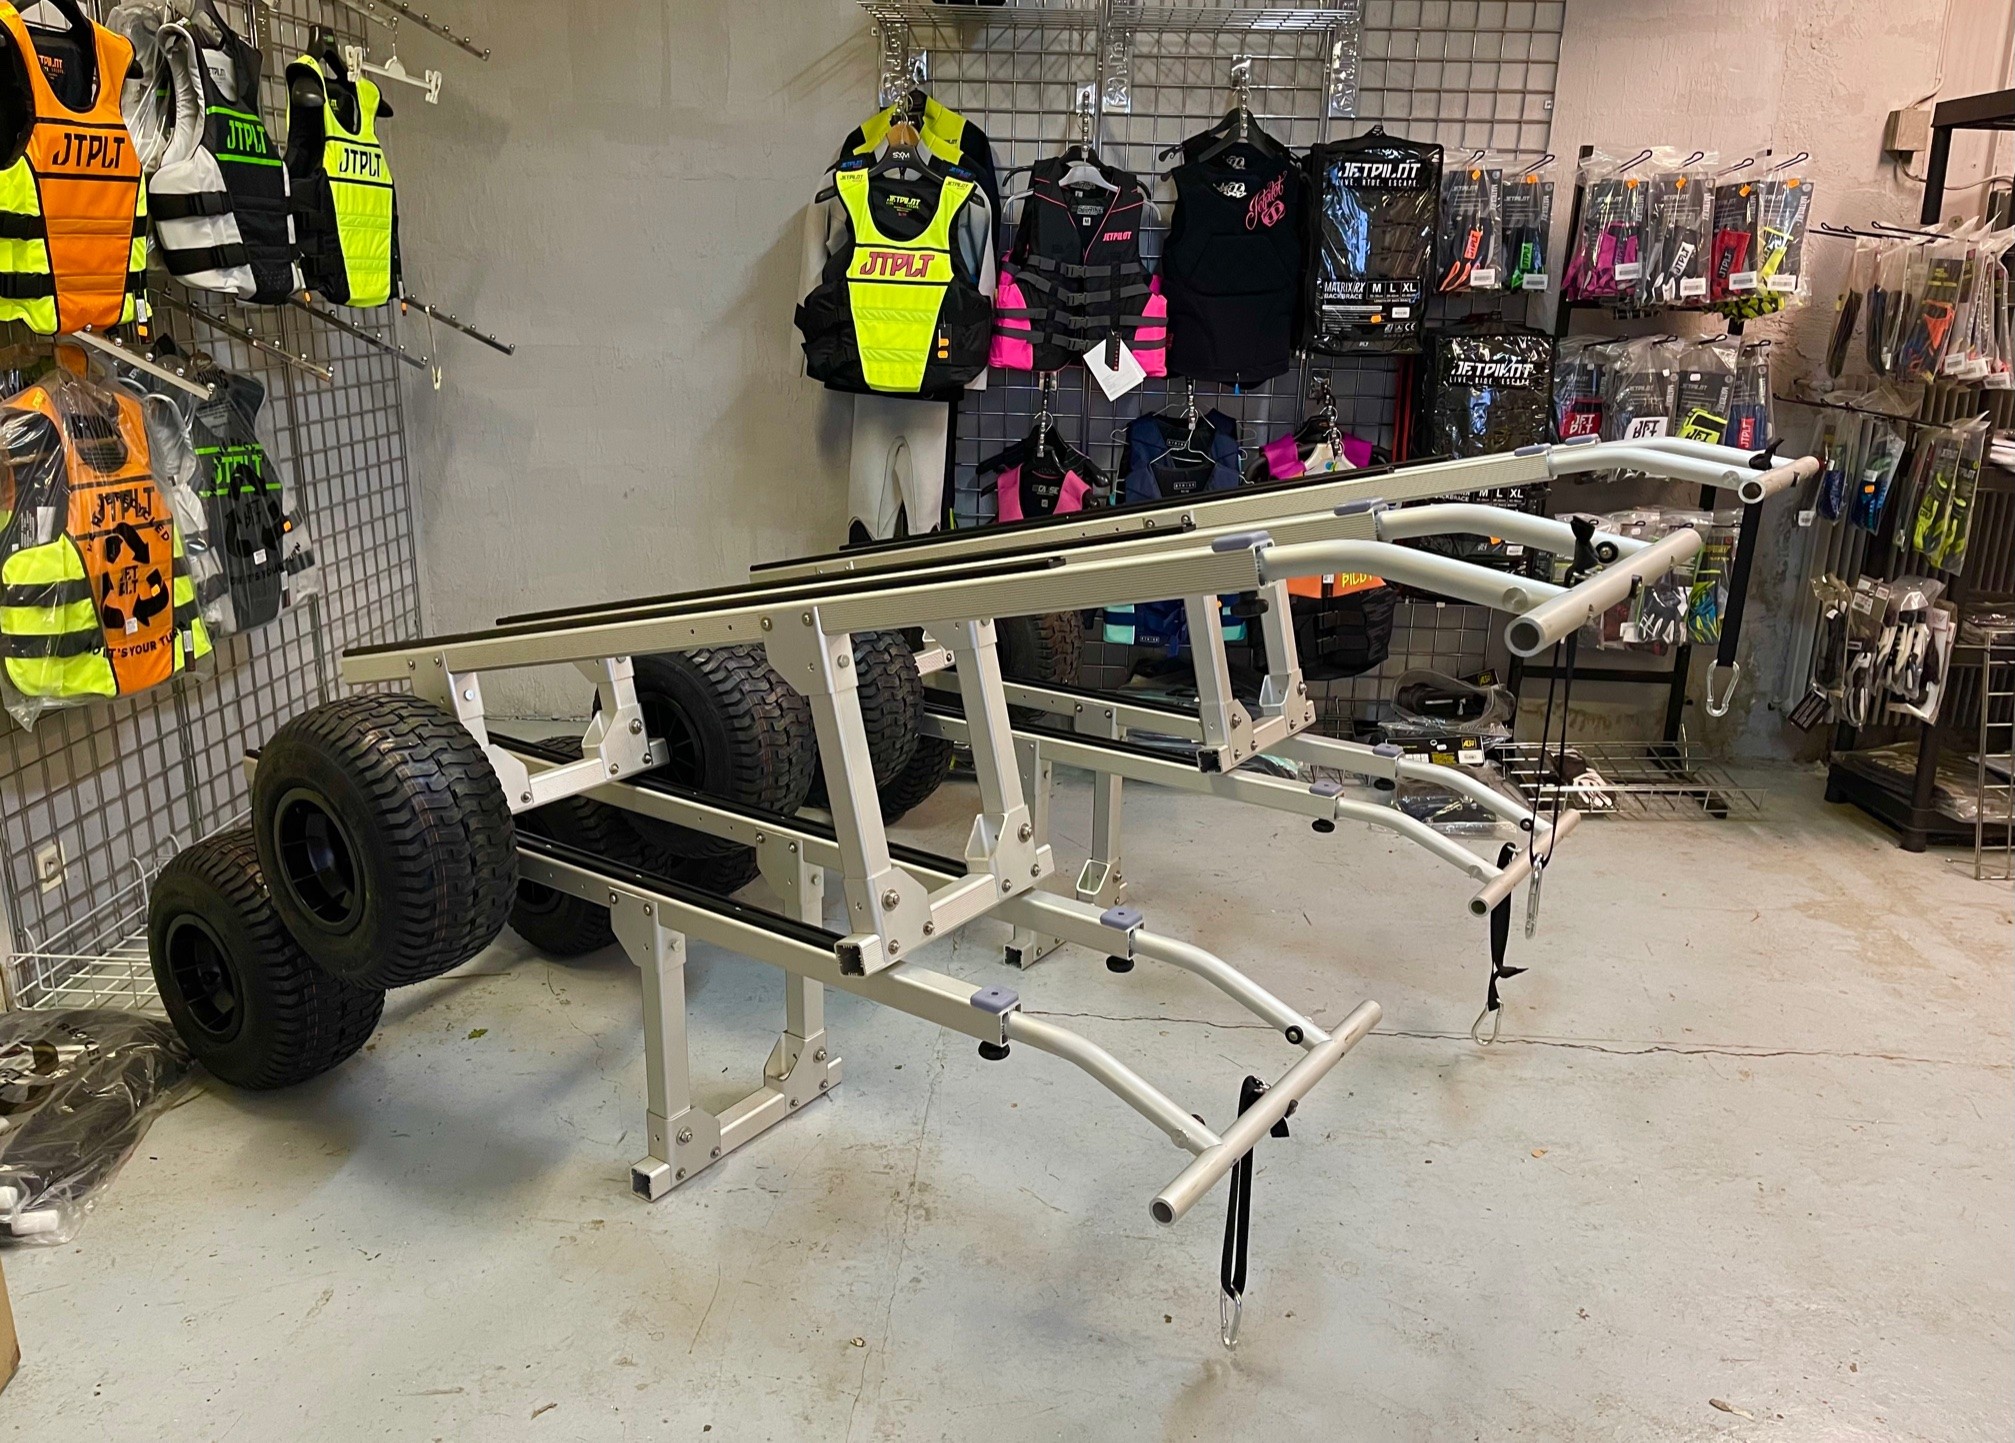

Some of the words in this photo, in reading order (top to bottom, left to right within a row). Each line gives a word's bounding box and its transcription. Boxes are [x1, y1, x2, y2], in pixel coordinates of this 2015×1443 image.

[226, 119, 267, 154] JTPLT
[52, 132, 125, 169] JTPLT
[339, 148, 382, 178] JTPLT
[1337, 162, 1421, 178] JETPILOT
[886, 194, 921, 206] JETPILOT
[1103, 231, 1132, 242] JETPILOT
[860, 251, 935, 278] JTPLT
[1675, 246, 1690, 273] JTPLT
[1718, 251, 1732, 278] JTPLT
[1372, 283, 1382, 293] M
[1389, 283, 1397, 293] L
[1402, 282, 1417, 293] XL
[1571, 414, 1596, 425] JET
[1568, 424, 1593, 434] PLT
[1684, 428, 1713, 442] JET
[1740, 419, 1752, 449] JTPLT
[1479, 488, 1489, 497] M
[1496, 488, 1503, 498] L
[1509, 488, 1524, 498] XL
[129, 641, 157, 655] YOUR
